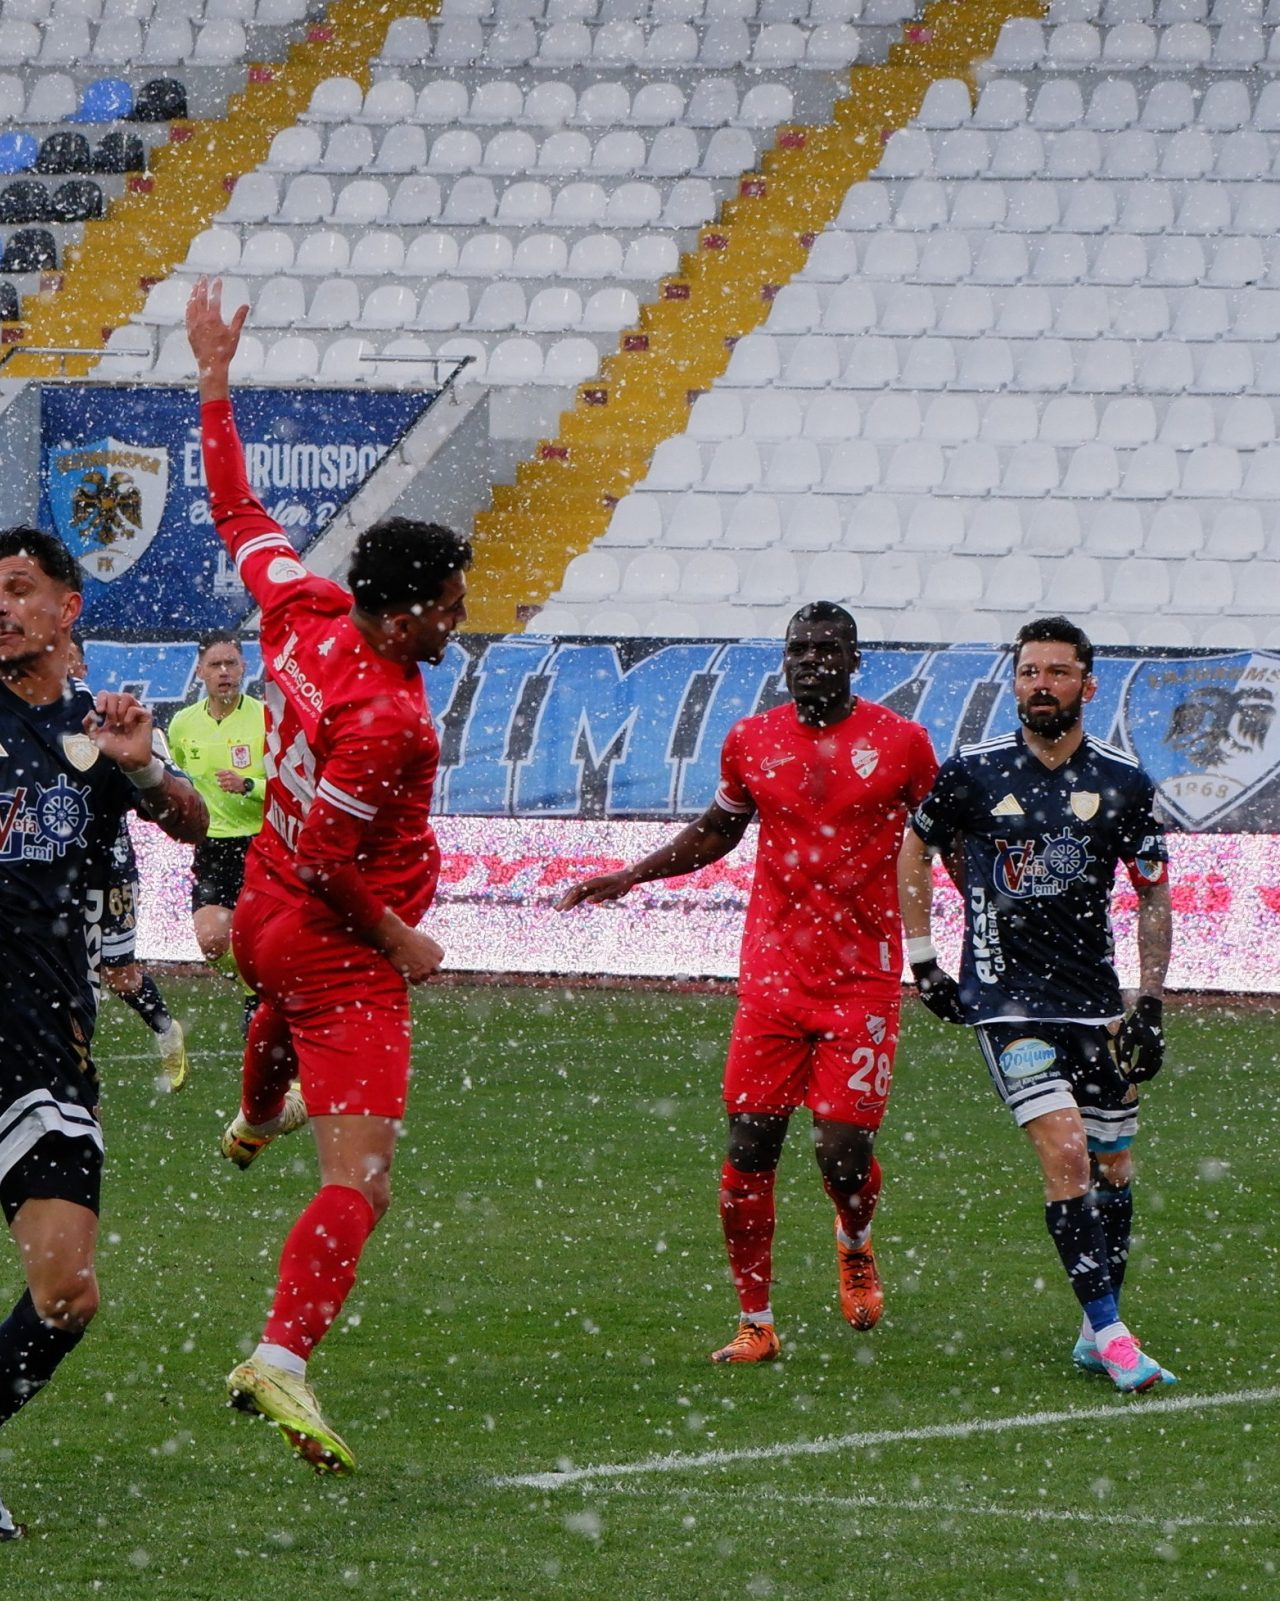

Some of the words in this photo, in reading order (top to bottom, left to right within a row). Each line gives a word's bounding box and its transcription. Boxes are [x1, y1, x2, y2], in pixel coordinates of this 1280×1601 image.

[993, 846, 1058, 898] Gemi
[995, 840, 1045, 892] Vefa
[971, 887, 998, 985] AKSU
[847, 1047, 890, 1097] 28
[999, 1048, 1057, 1072] Doyum
